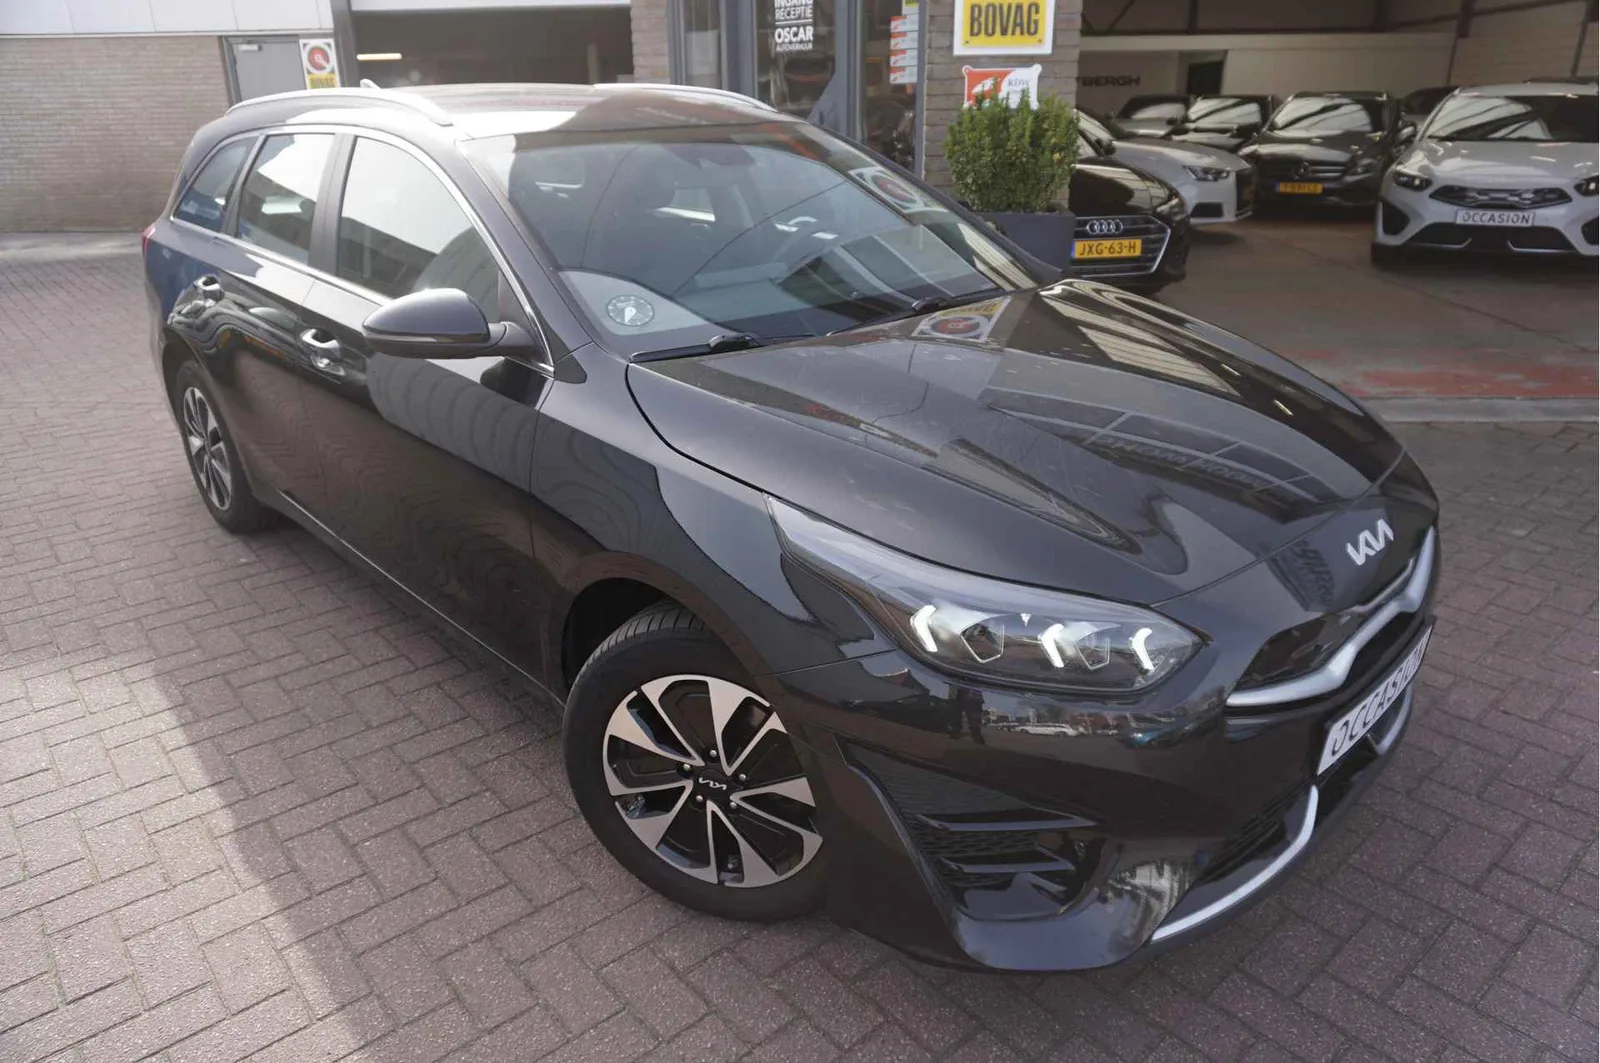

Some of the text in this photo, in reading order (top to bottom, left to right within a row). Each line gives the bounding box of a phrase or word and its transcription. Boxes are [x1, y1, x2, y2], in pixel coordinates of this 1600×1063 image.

[775, 6, 813, 20] RECEPTIE
[969, 3, 1040, 37] BOVAG
[775, 26, 814, 43] OSCAR
[1462, 211, 1531, 225] OCCASION
[1080, 241, 1137, 256] JXG-63-H
[1346, 518, 1395, 566] KIA
